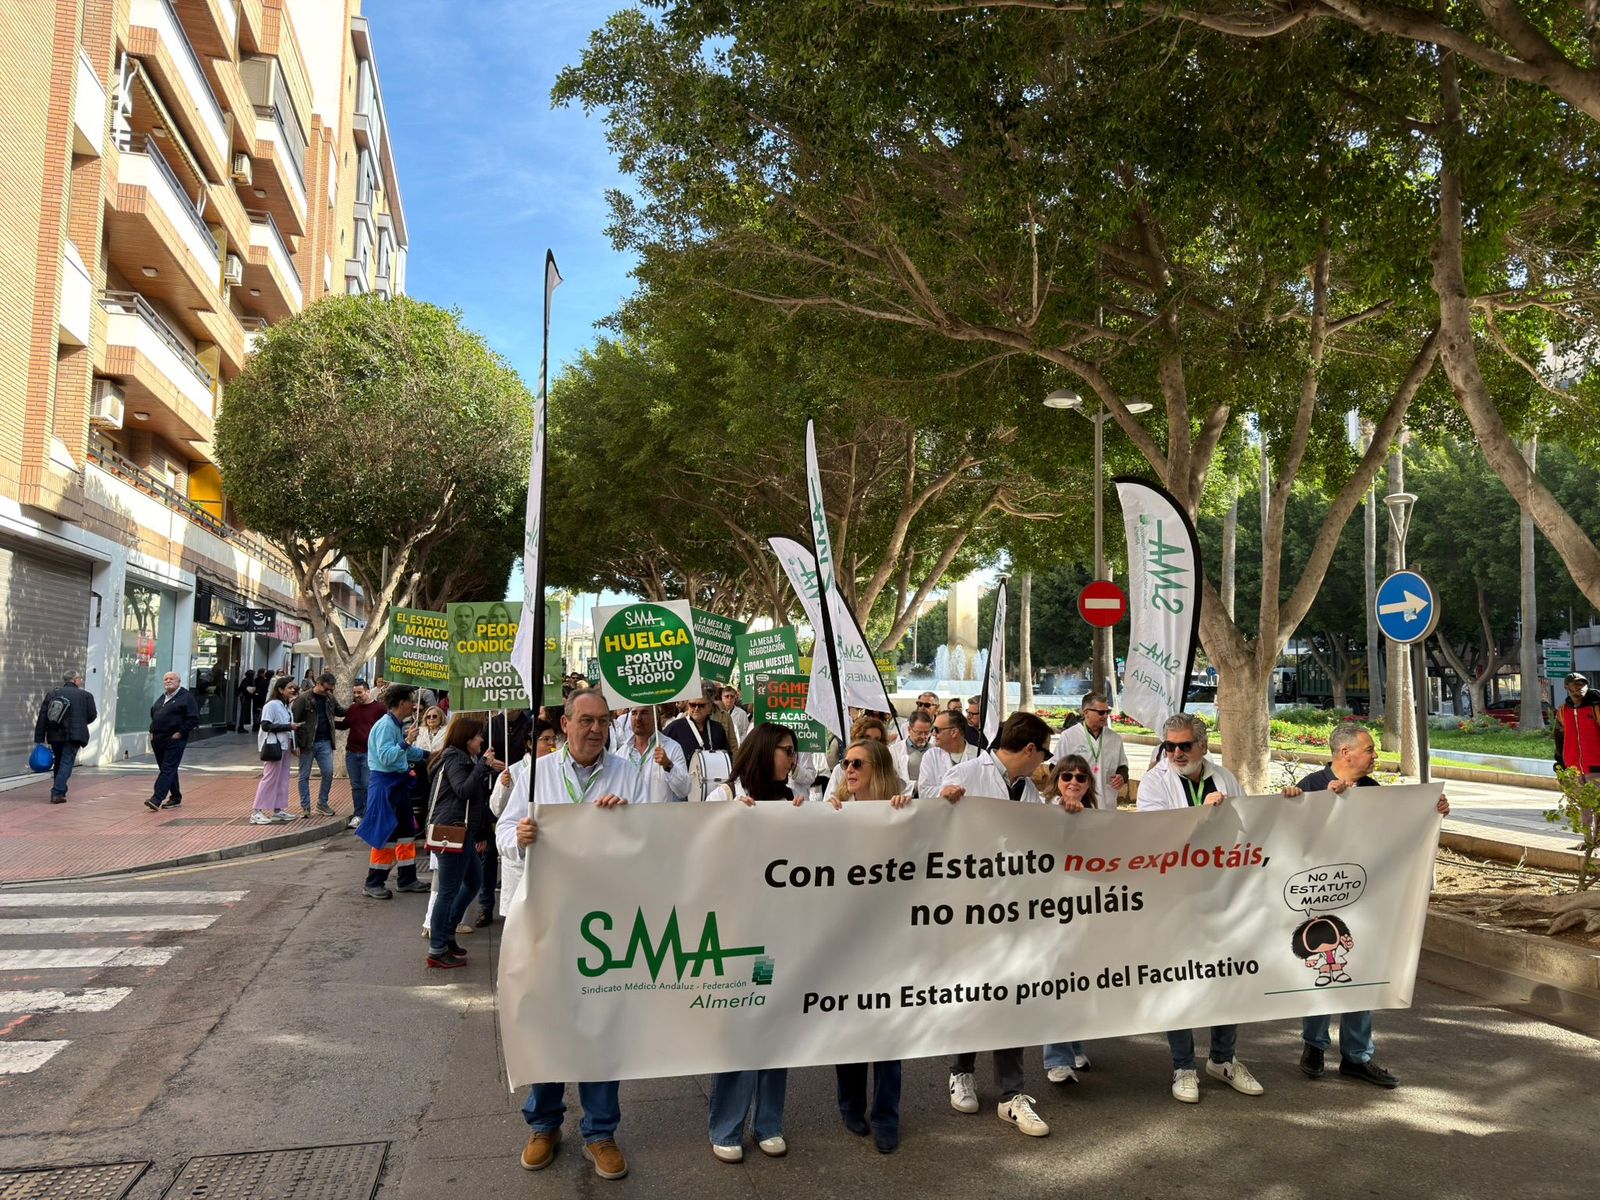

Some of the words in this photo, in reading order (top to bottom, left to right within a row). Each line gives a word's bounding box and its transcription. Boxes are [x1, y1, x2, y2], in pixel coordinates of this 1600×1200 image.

[396, 612, 408, 623] EL
[410, 614, 447, 628] ESTATU
[625, 610, 662, 626] SMA
[698, 616, 707, 624] LA
[707, 617, 723, 629] MESA
[724, 623, 733, 632] DE
[405, 624, 449, 640] MARCO
[477, 623, 519, 638] PEOR
[694, 624, 733, 641] NEGOCIACIÓN
[393, 634, 414, 646] NOS
[416, 637, 449, 651] IGNOR
[456, 638, 557, 654] CONDICS
[604, 628, 689, 653] HUELGA
[705, 637, 734, 655] NUESTRA
[749, 639, 757, 648] LA
[757, 635, 774, 647] MESA
[774, 633, 782, 643] DE
[402, 651, 444, 663] QUEREMOS
[748, 642, 786, 657] NEGOCIACIÓN
[390, 657, 449, 672] RECONOCIMIENT
[624, 653, 651, 666] POR
[653, 650, 673, 662] UN
[697, 649, 732, 668] OTACIÓN
[743, 659, 765, 672] FIRMA
[765, 653, 794, 668] NUESTRA
[390, 665, 402, 673] NO
[479, 661, 512, 676] ¡POR
[617, 659, 683, 677] ESTATUTO
[464, 675, 512, 689] MARCO
[627, 671, 675, 686] PROPIO
[767, 680, 810, 695] GAME
[765, 711, 778, 720] SE
[765, 859, 835, 888] Con
[847, 858, 916, 886] este
[926, 850, 1055, 879] Estatuto
[1064, 854, 1121, 873] nos
[1127, 843, 1270, 874] explotáis,
[1308, 873, 1328, 882] NO
[1333, 870, 1349, 880] AL
[1290, 880, 1361, 894] ESTATUTO
[911, 904, 954, 926] no
[965, 901, 1020, 925] nos
[1029, 885, 1144, 924] reguláis
[577, 904, 765, 983] SMA
[581, 984, 622, 995] Sindicato
[624, 981, 657, 991] Médico
[659, 981, 694, 991] Andaluz
[702, 980, 747, 990] Federación
[803, 992, 848, 1014] Por
[857, 992, 891, 1010] un
[900, 982, 1009, 1007] Estatuto
[1016, 972, 1090, 1005] propio
[1096, 965, 1131, 989] del
[1137, 957, 1259, 985] Facultativo
[689, 992, 766, 1009] Almería
